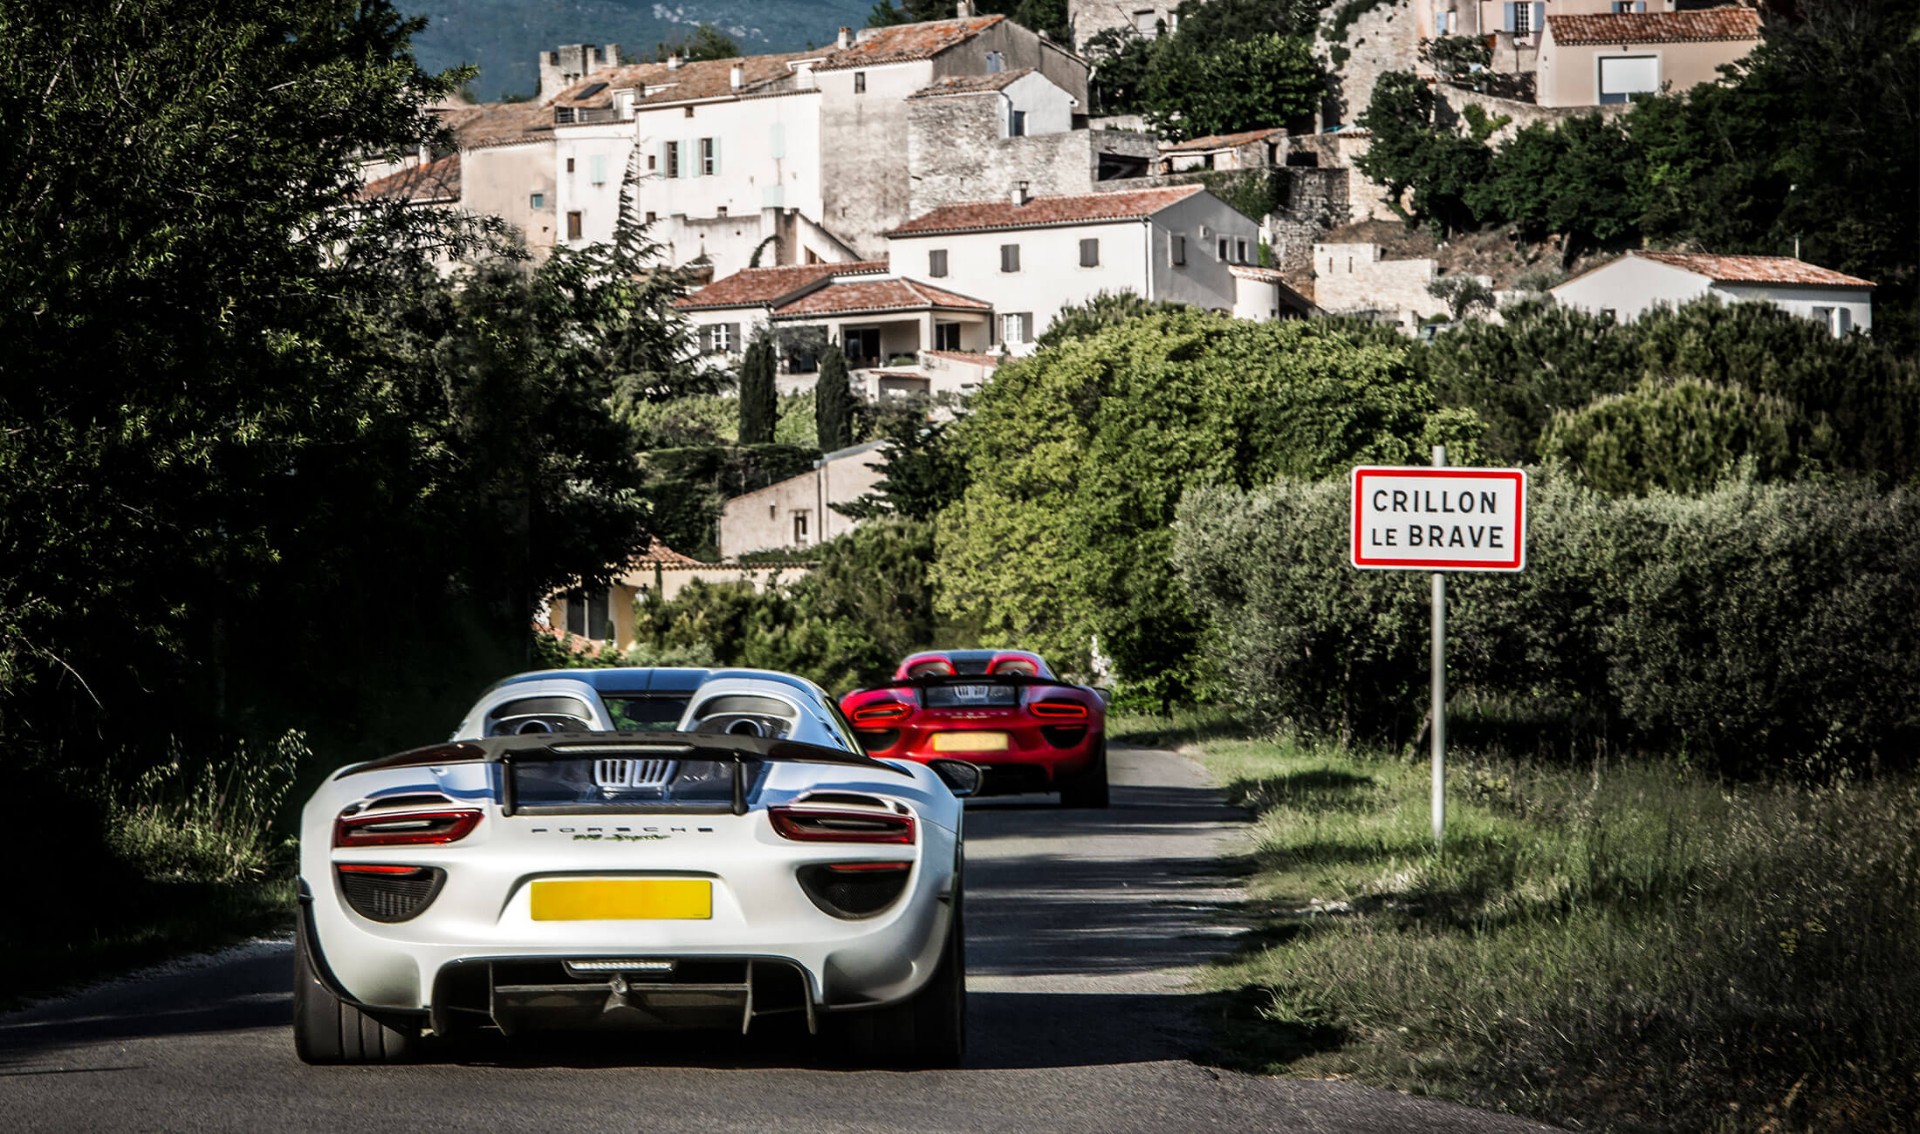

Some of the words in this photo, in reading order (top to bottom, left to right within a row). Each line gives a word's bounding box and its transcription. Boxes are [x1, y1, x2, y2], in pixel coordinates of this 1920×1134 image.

[1373, 490, 1496, 513] CRILLON
[1372, 528, 1397, 546] LE
[1409, 525, 1504, 548] BRAVE
